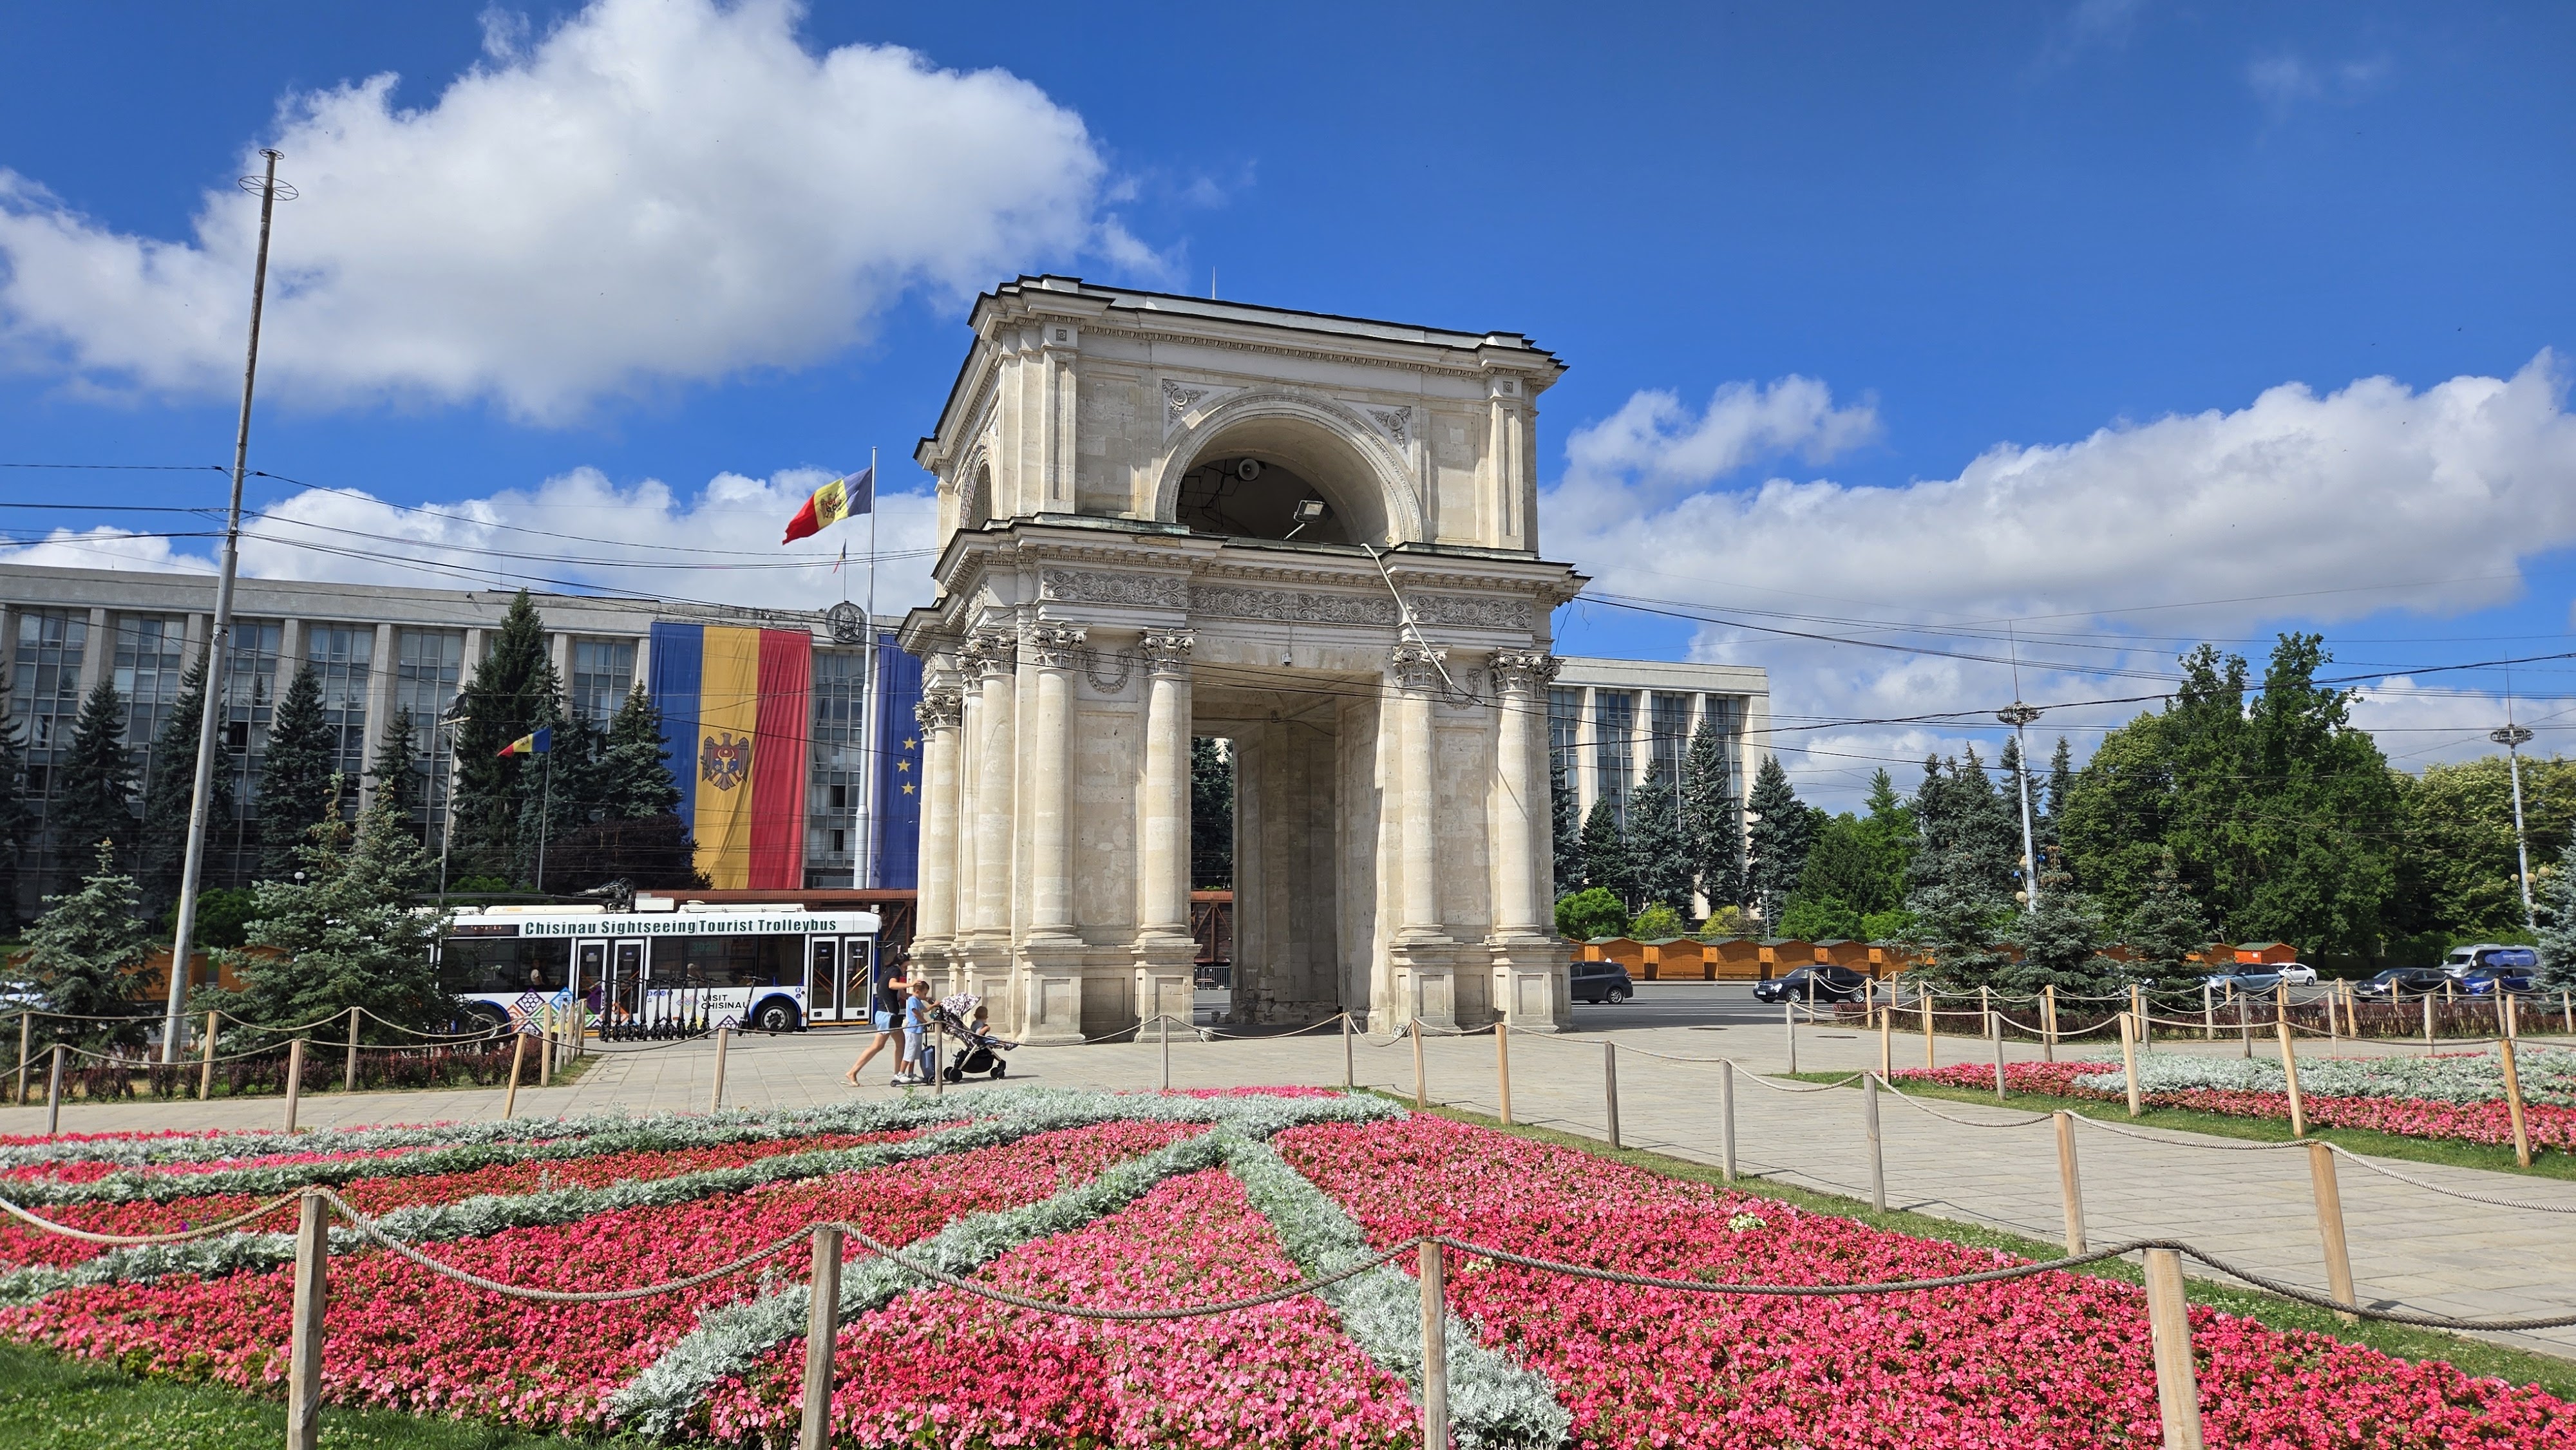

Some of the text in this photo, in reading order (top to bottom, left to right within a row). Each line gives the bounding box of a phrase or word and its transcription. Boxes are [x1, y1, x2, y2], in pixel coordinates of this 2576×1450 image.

[526, 919, 837, 934] Chisinau Sightseeing Tourist Trolleybus
